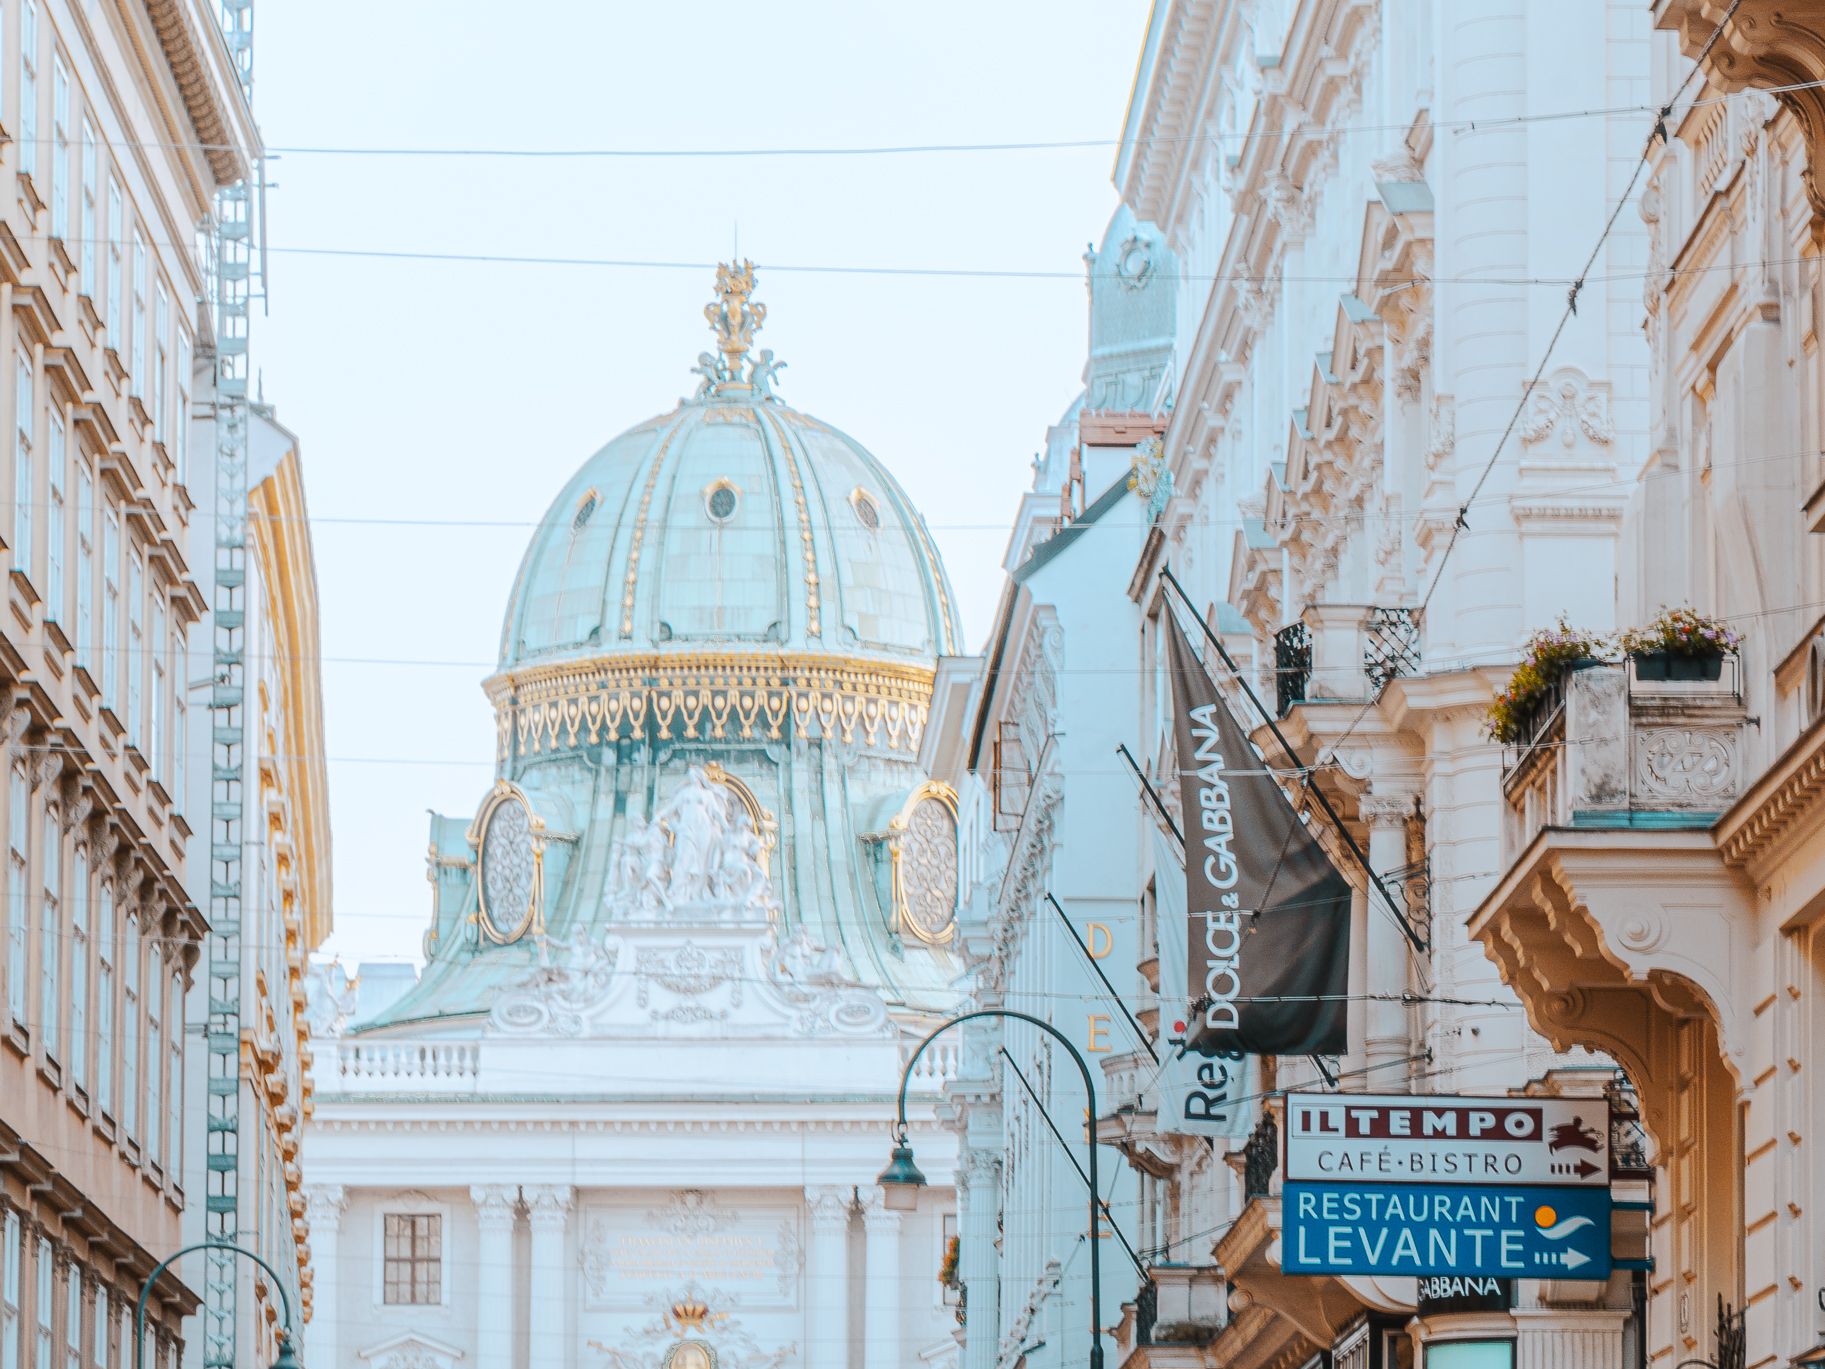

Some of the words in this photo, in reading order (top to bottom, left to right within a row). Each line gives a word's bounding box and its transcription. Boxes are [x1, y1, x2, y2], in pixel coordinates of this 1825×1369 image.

[1189, 702, 1239, 890] GABBANA
[1220, 892, 1241, 910] &
[1206, 910, 1241, 1030] DOLCE
[1300, 1109, 1340, 1133] IL
[1350, 1109, 1535, 1138] TEMPO
[1299, 1192, 1525, 1223] RESTAURANT
[1298, 1225, 1526, 1269] LEVANTE
